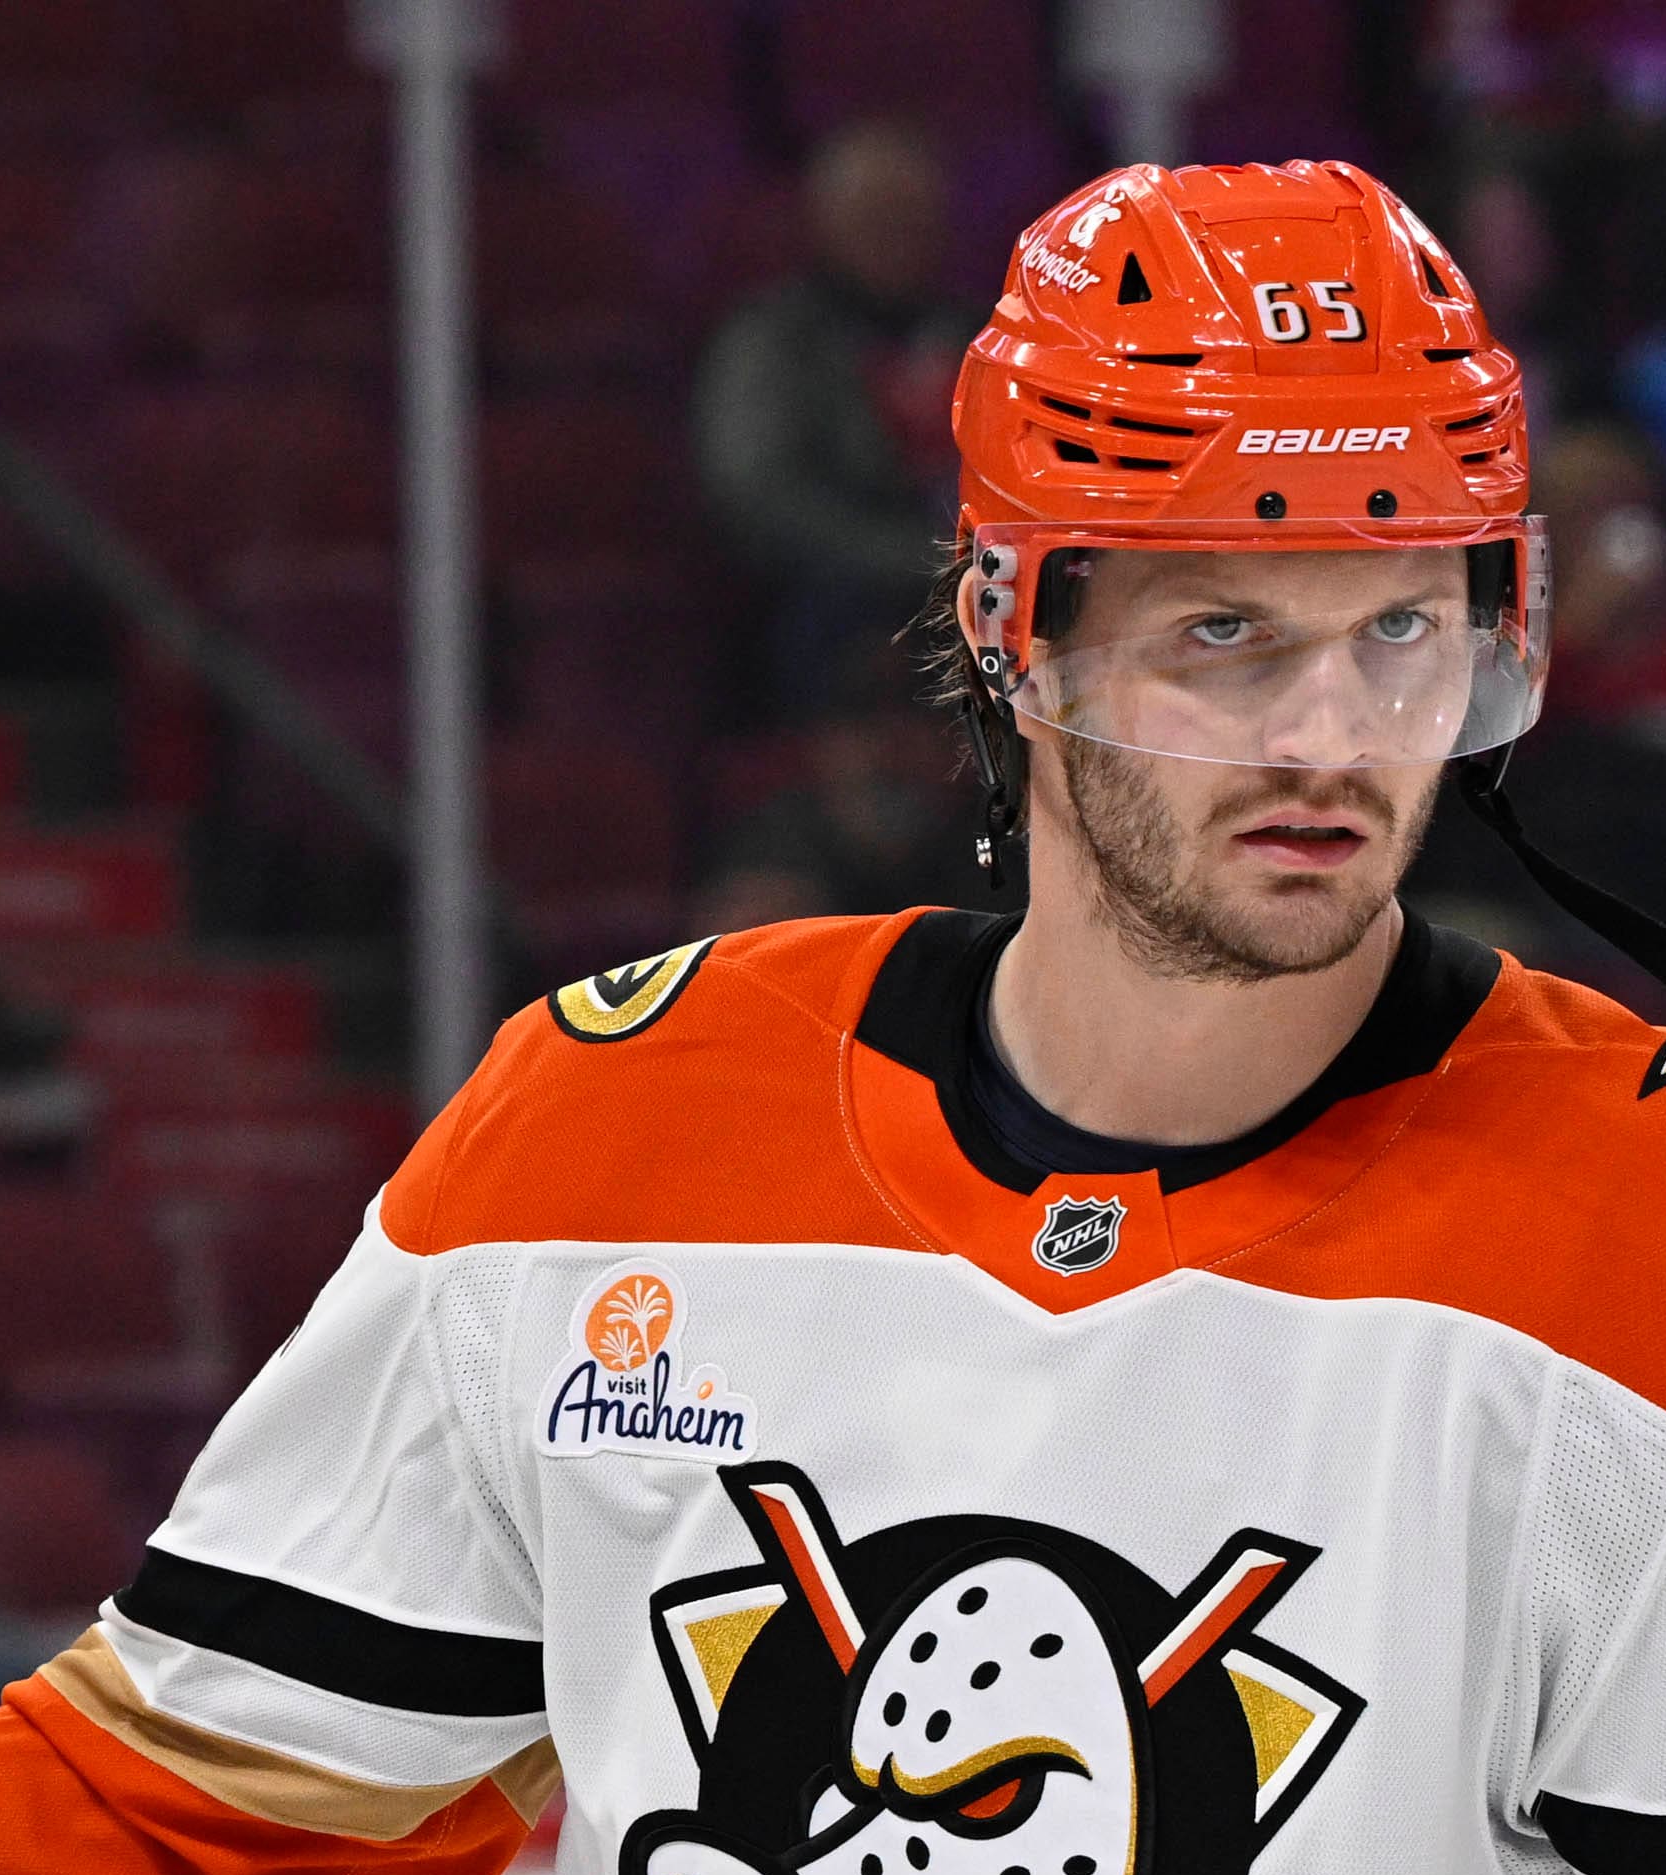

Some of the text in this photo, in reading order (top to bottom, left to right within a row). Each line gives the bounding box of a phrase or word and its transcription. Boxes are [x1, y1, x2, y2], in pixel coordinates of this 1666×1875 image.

[1252, 282, 1366, 343] 65
[1237, 426, 1410, 455] BAUER
[1053, 1218, 1107, 1254] NHL
[548, 1351, 744, 1450] Anaheim
[607, 1375, 647, 1396] visit
